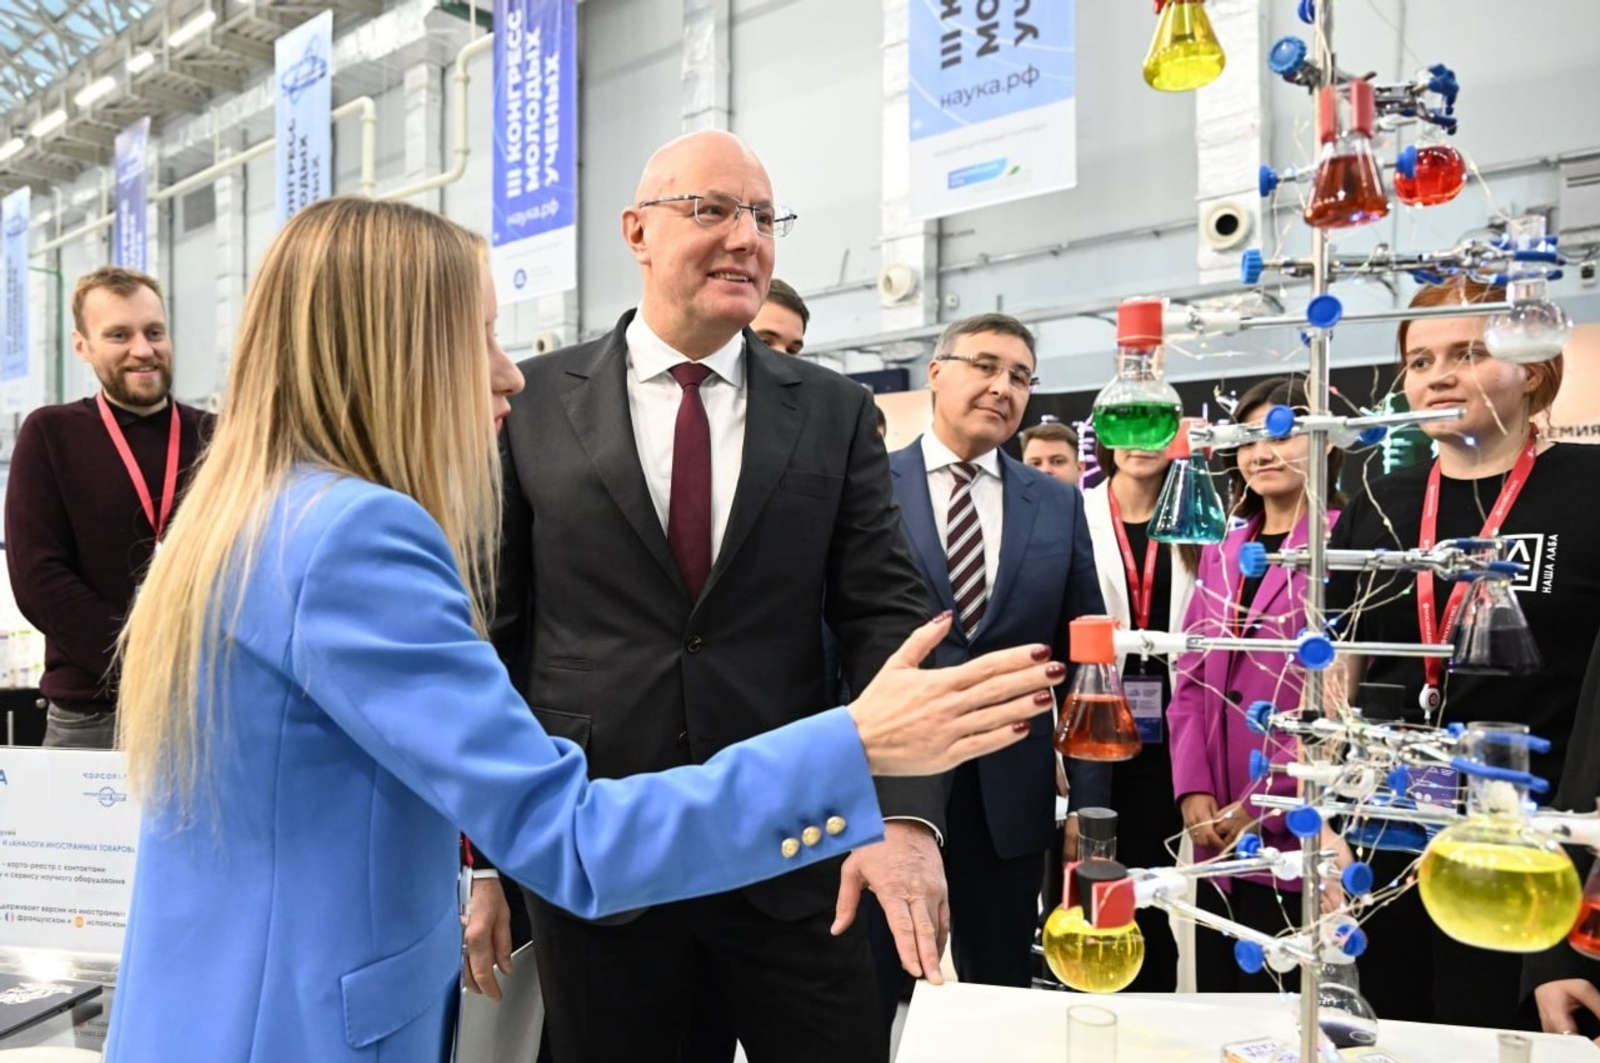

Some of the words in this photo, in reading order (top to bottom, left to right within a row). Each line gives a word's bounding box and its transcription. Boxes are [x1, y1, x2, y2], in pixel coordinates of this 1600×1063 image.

[941, 29, 962, 70] III
[507, 8, 522, 163] КОНГРЕСС
[939, 63, 1041, 110] наука.рф
[525, 26, 541, 193] МОЛОДЫХ
[544, 52, 560, 187] УЧЕНЫХ
[507, 168, 522, 198] III
[507, 197, 560, 227] наука.рф
[1545, 534, 1559, 561] ЛАБА
[1541, 563, 1555, 594] НАША
